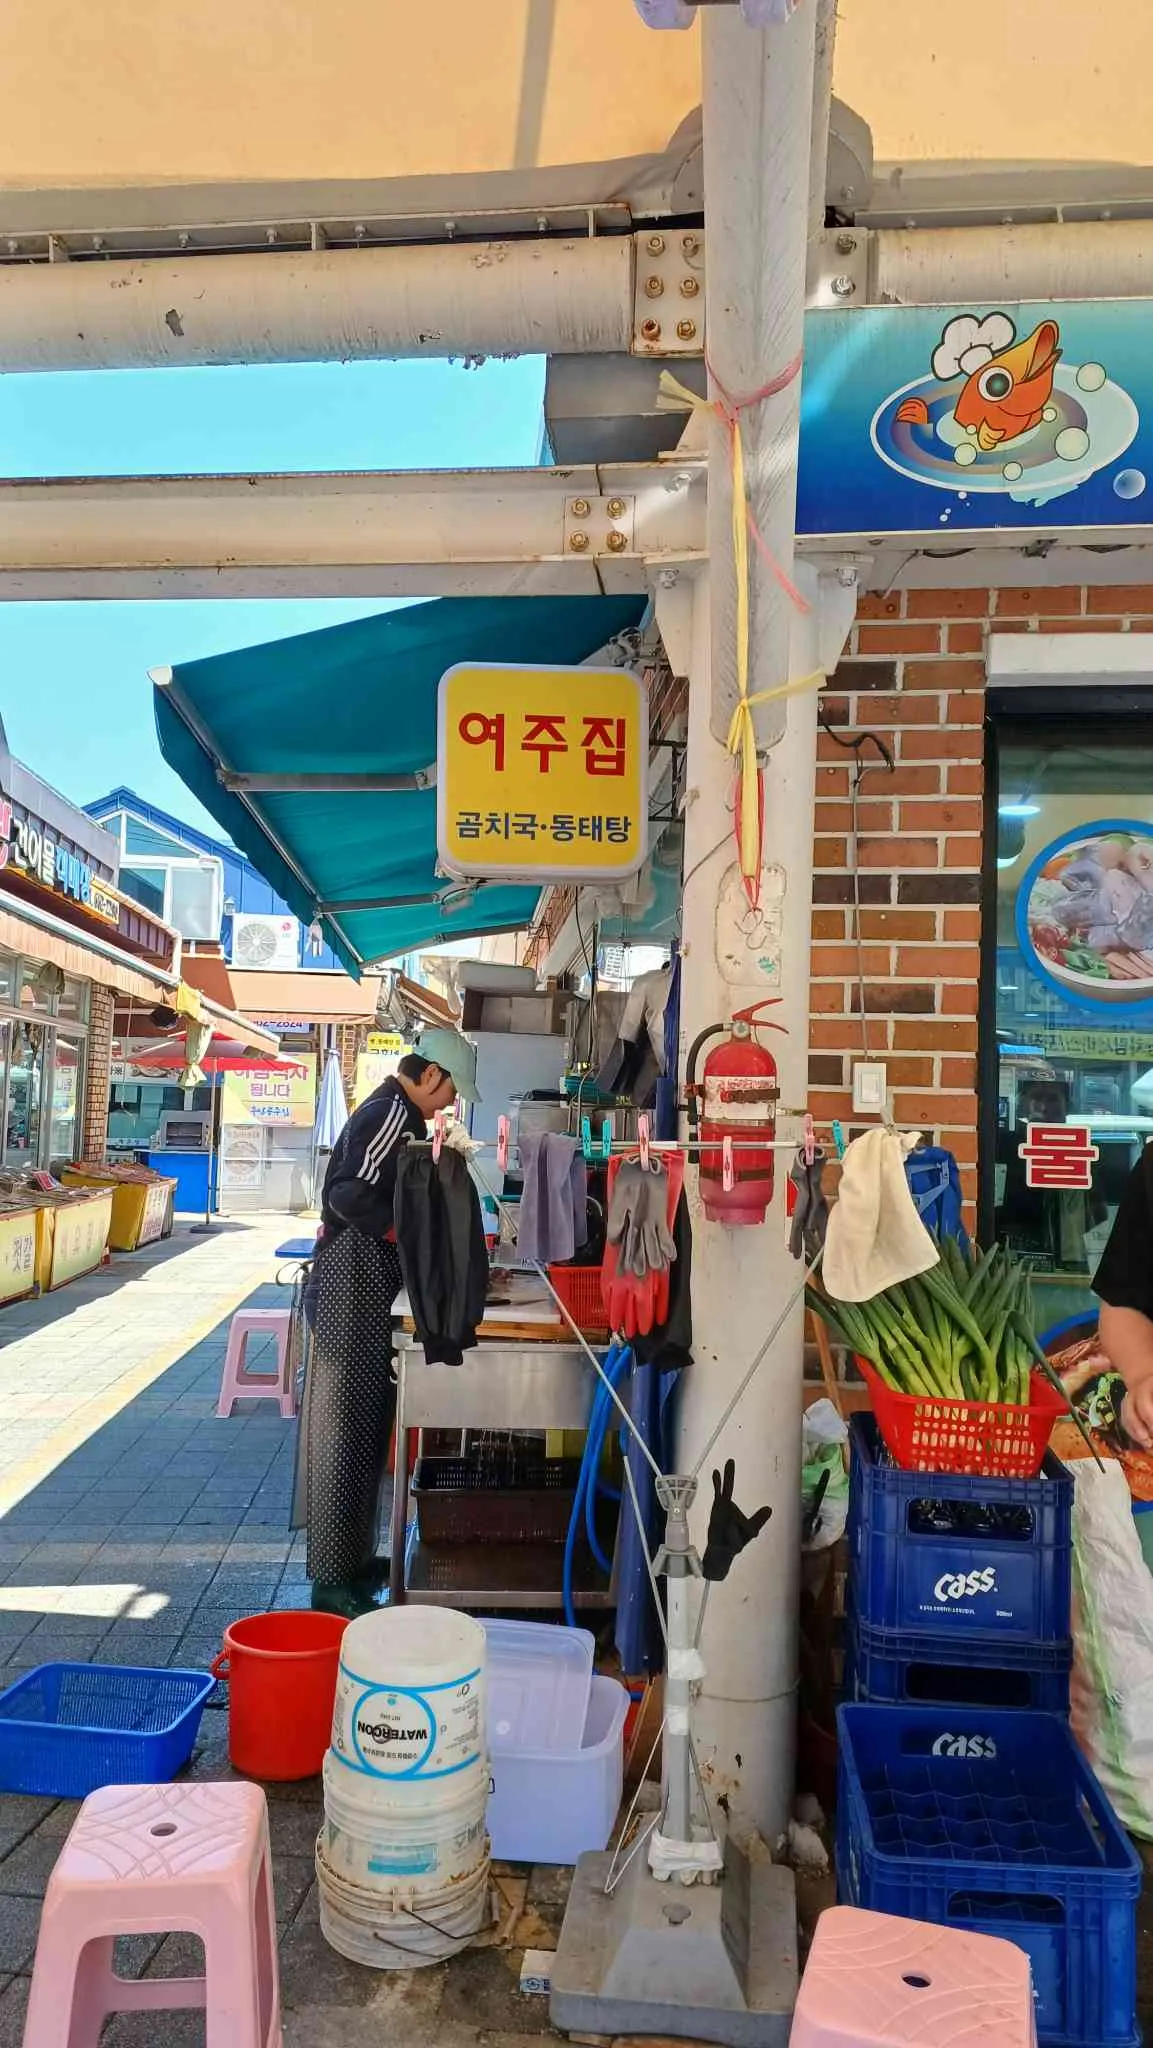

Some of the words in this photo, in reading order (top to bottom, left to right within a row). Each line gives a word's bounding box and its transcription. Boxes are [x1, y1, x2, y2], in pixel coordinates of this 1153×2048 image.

[458, 711, 626, 777] 여주집
[11, 818, 56, 886] 건어물
[455, 810, 632, 844] 곰치국·동태탕
[250, 1083, 291, 1098] 됩니다
[1018, 1122, 1099, 1189] 물
[357, 1720, 428, 1742] WATERCON
